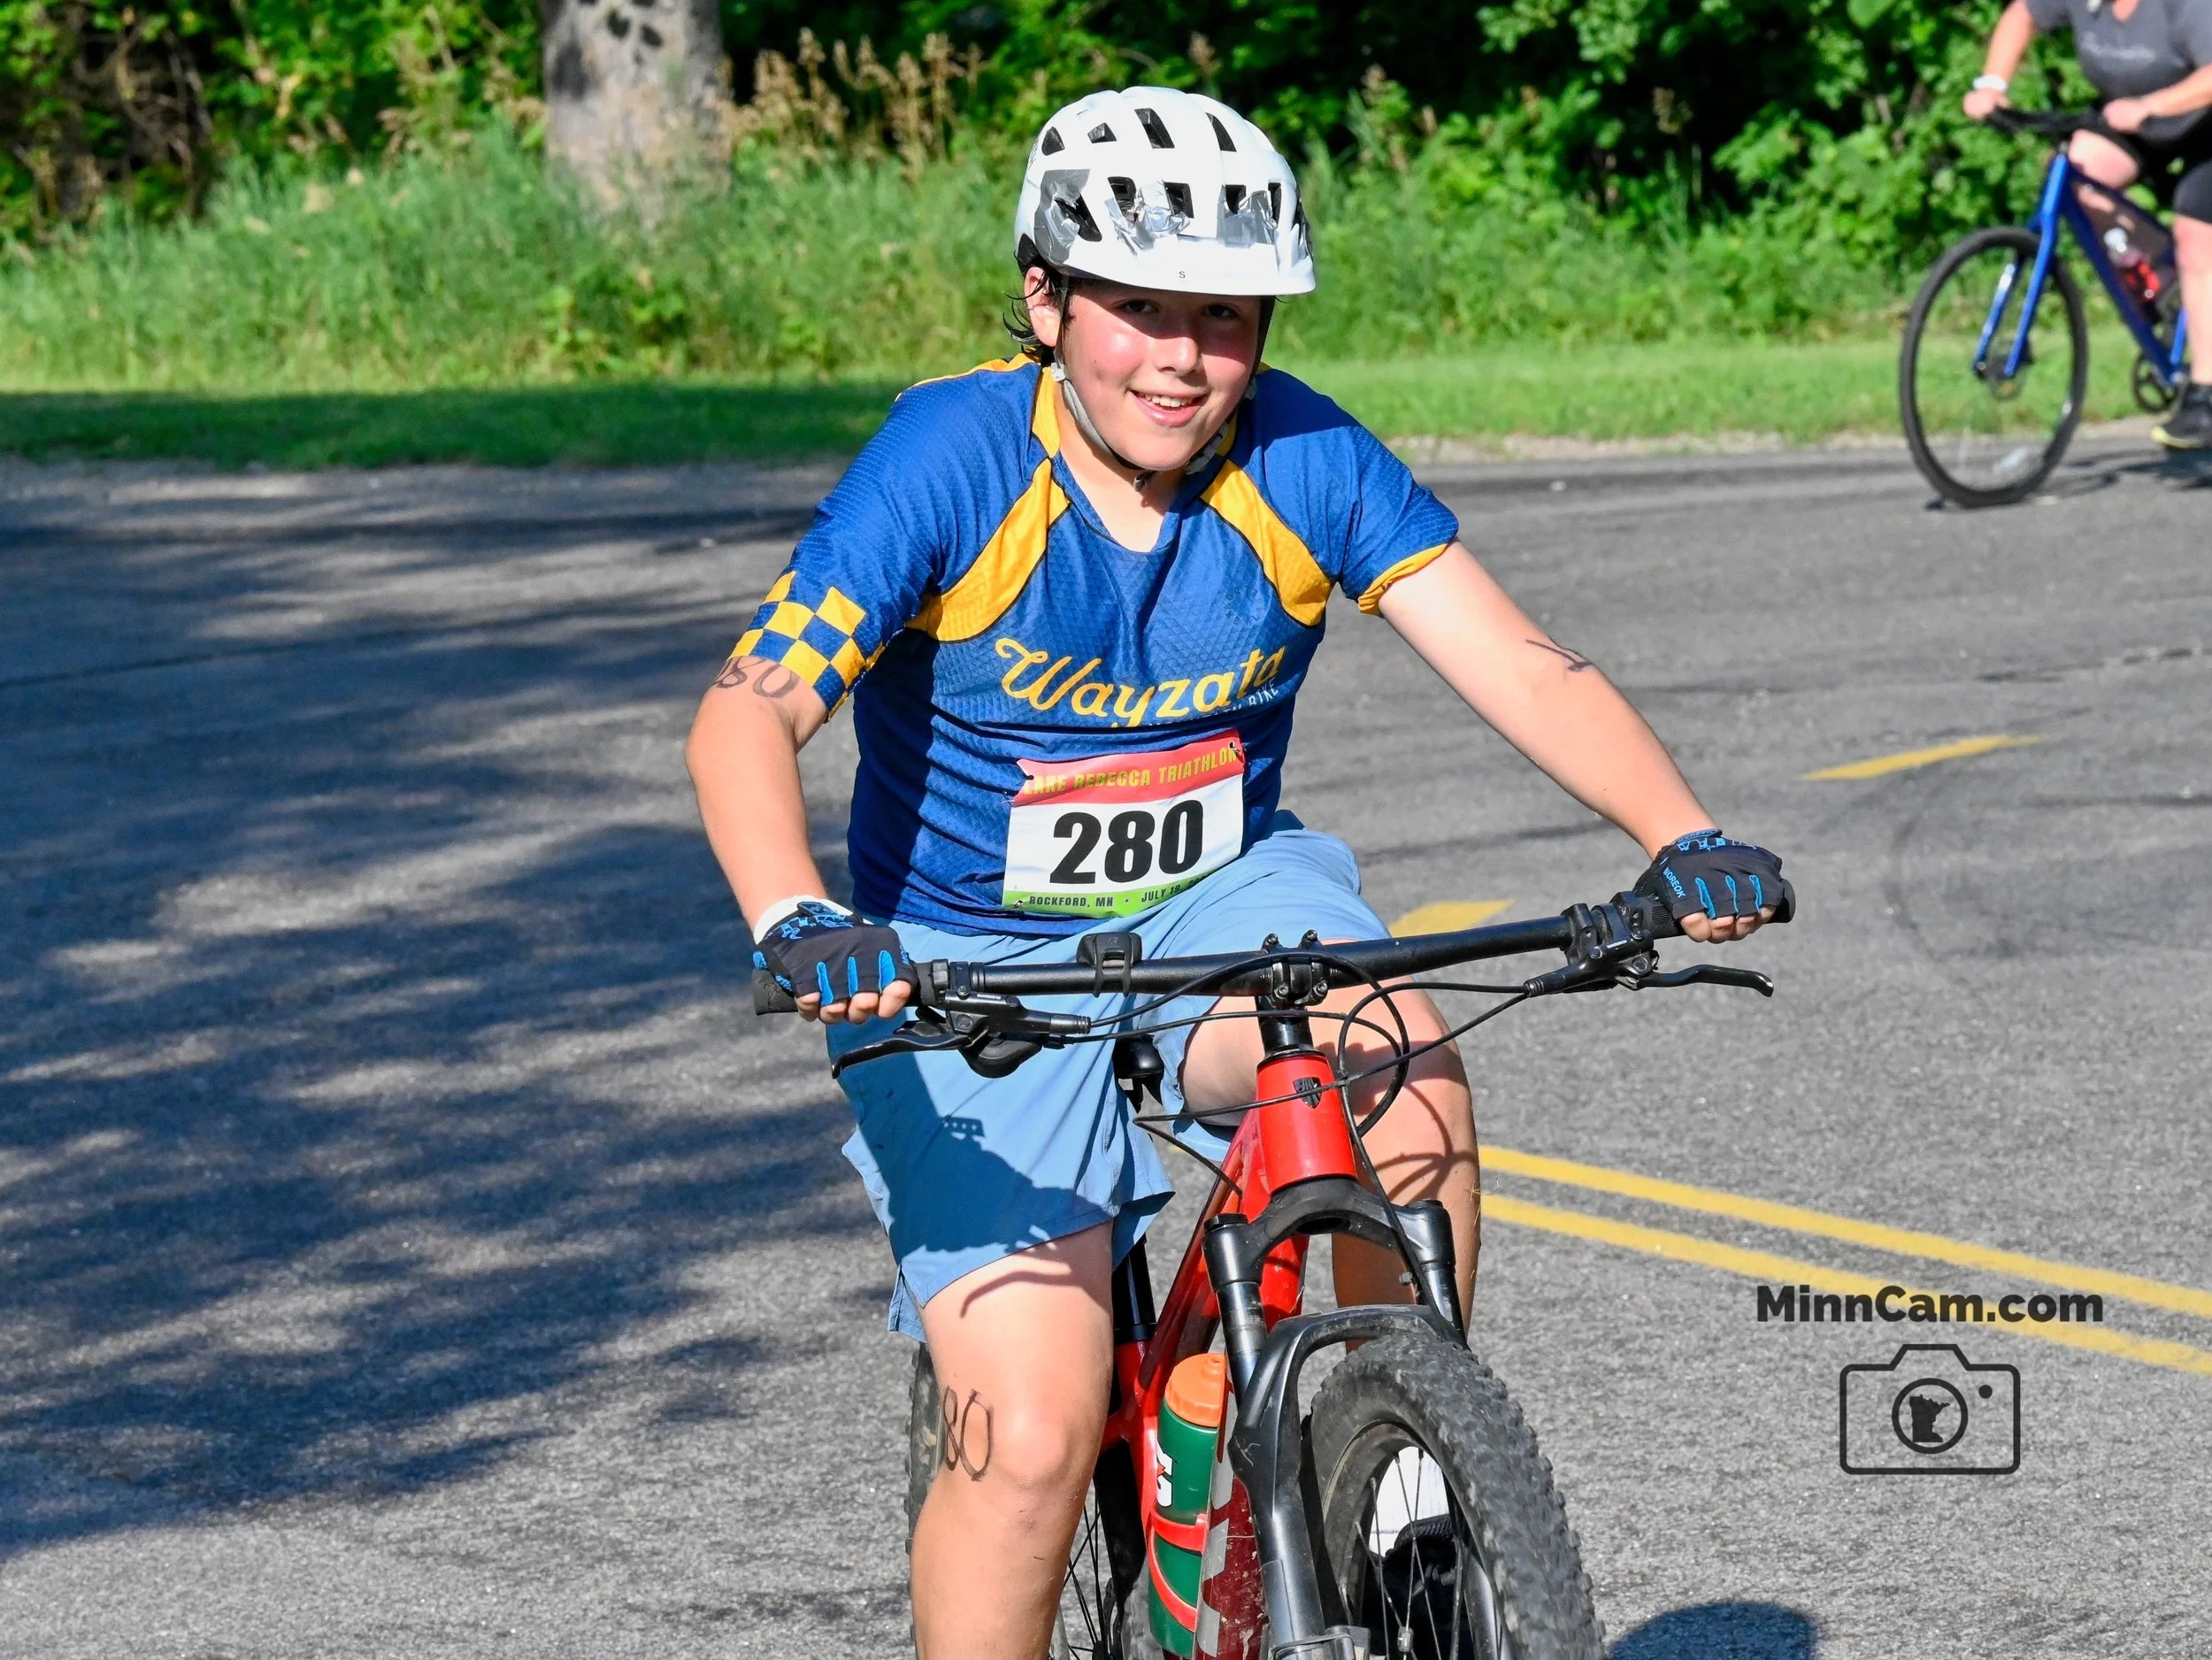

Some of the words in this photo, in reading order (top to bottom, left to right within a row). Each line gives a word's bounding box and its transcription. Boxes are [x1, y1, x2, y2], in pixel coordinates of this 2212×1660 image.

[712, 656, 801, 699] 80
[995, 637, 1287, 728] Wayzata
[1073, 769, 1151, 789] REBECCA
[1049, 799, 1204, 885] 280
[1029, 895, 1091, 908] ROCKFORD,
[1095, 896, 1114, 907] MN
[1141, 888, 1167, 903] JULY
